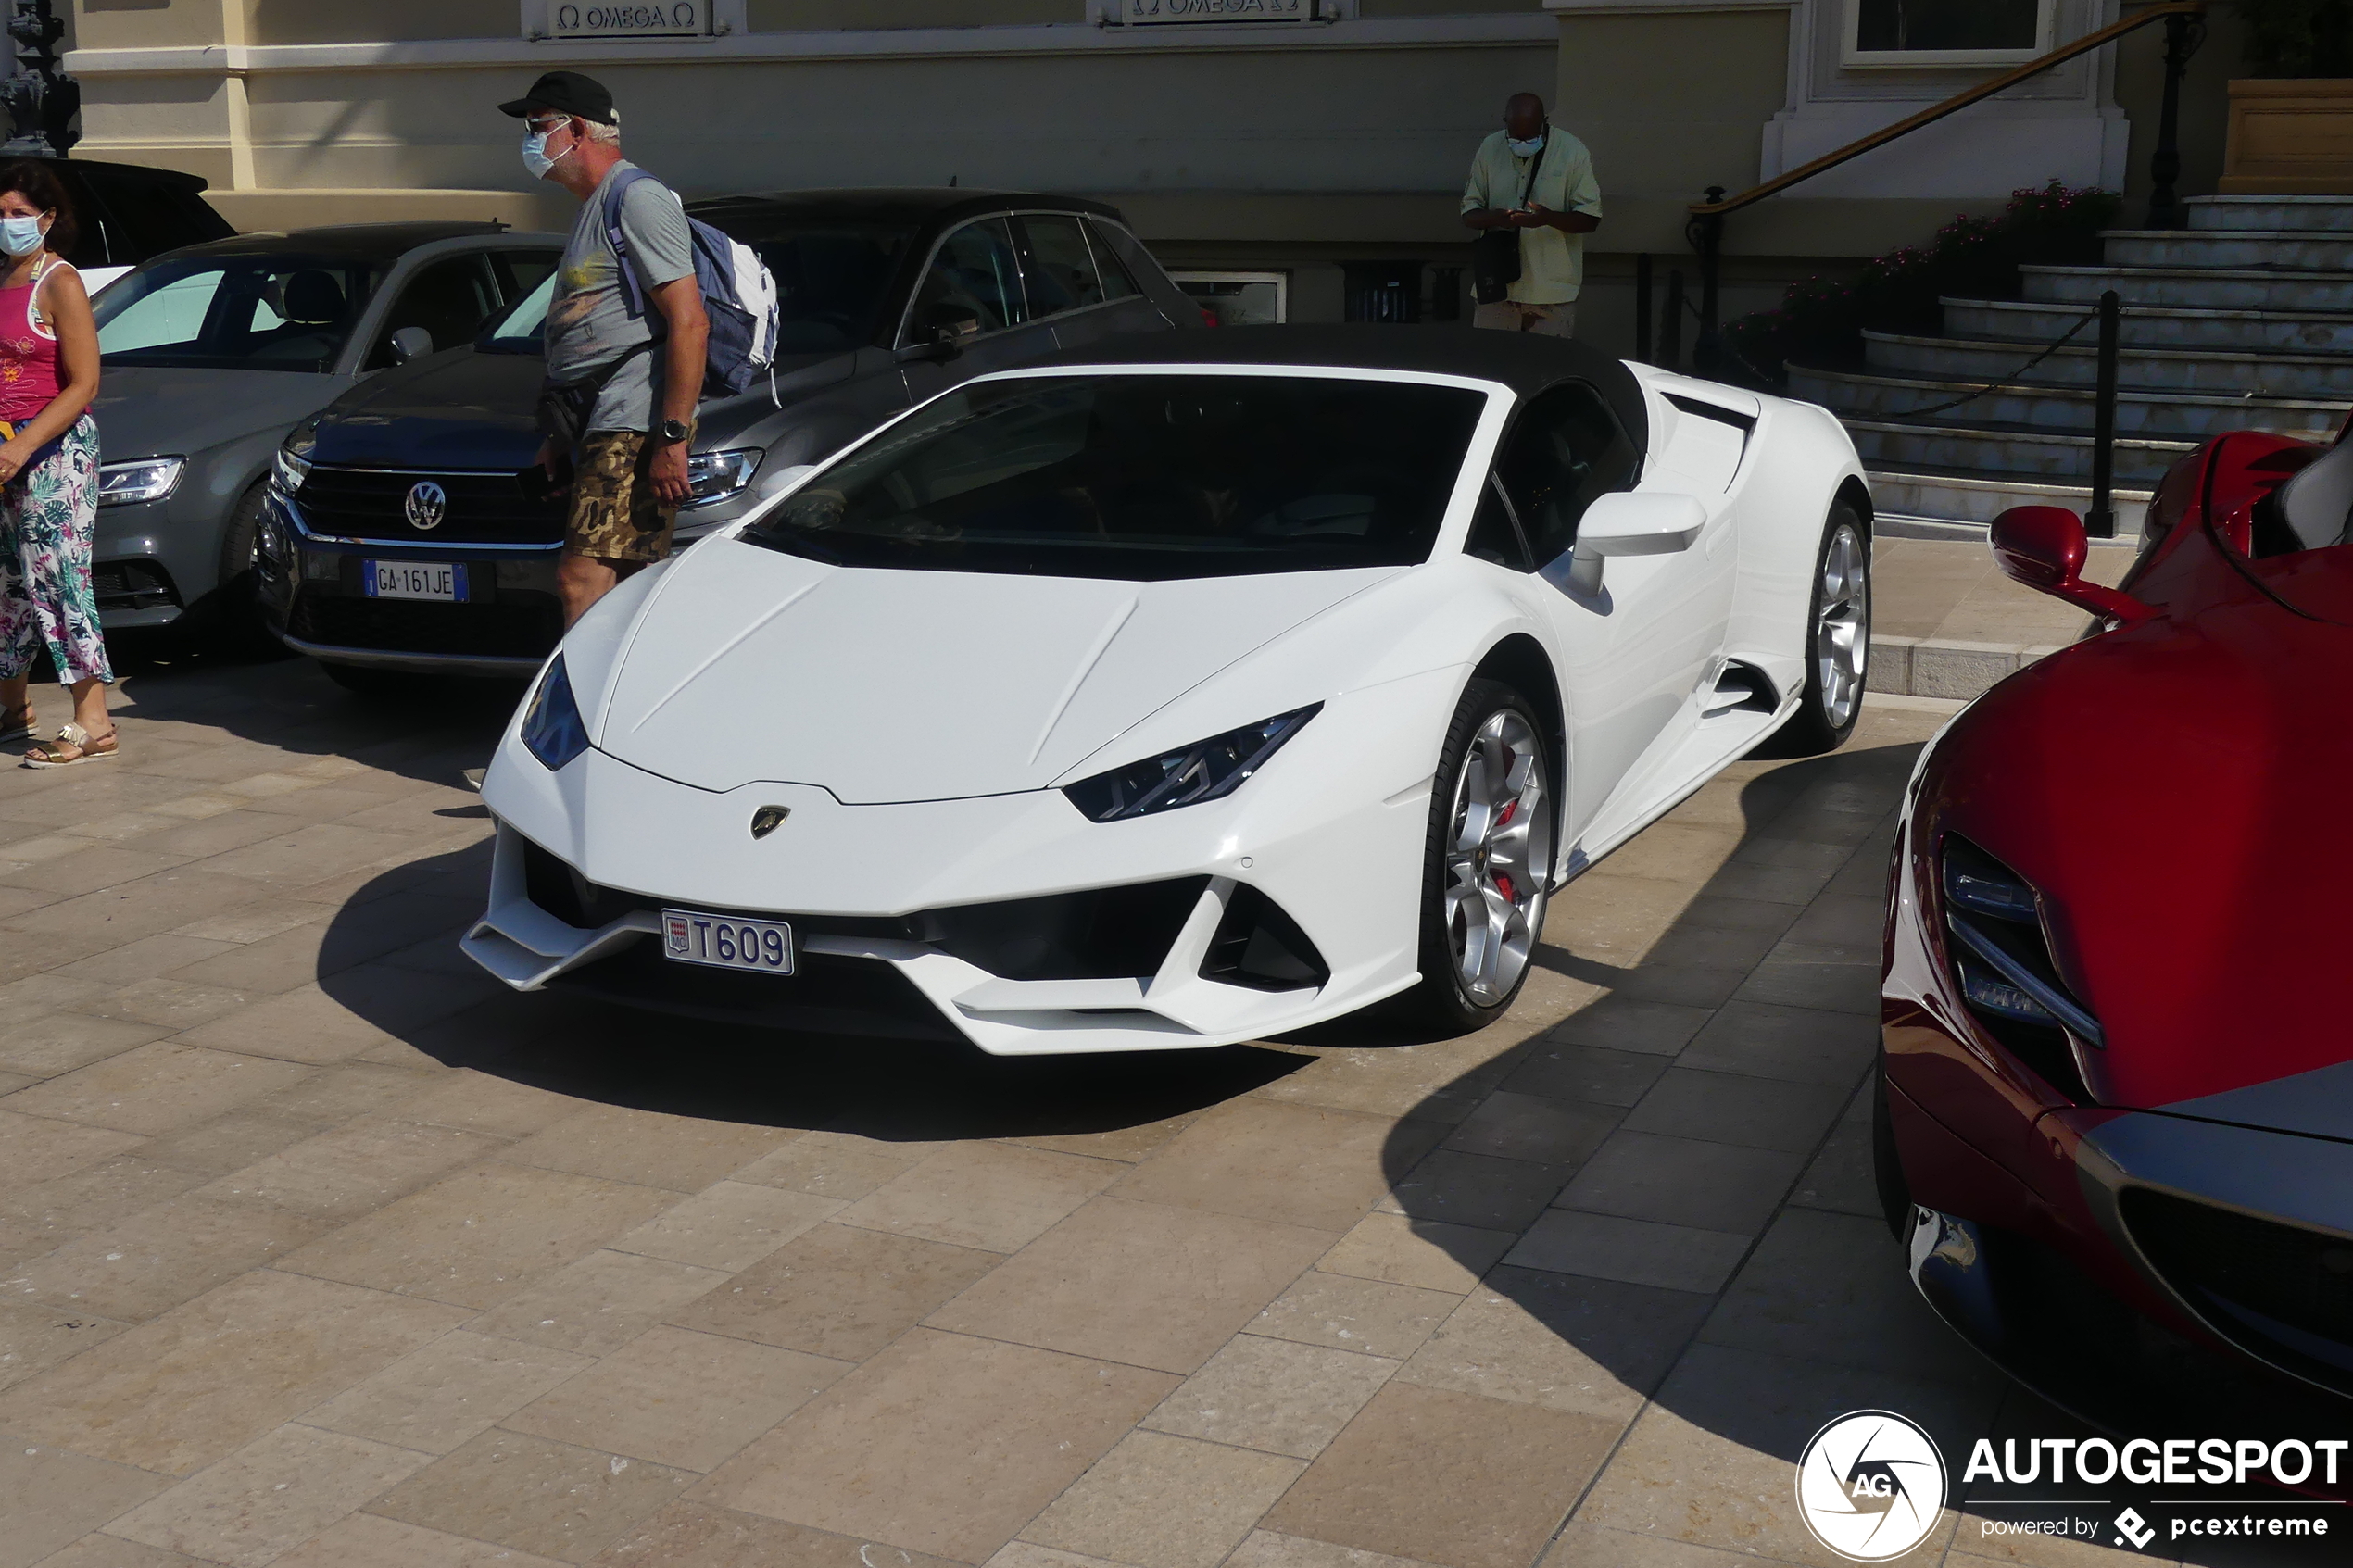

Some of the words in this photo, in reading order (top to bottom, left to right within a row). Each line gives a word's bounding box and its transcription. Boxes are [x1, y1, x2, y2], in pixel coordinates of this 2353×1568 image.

[586, 6, 666, 29] OMEGA
[1168, 0, 1264, 15] OMEGA
[672, 936, 686, 948] MC
[693, 920, 786, 967] T609
